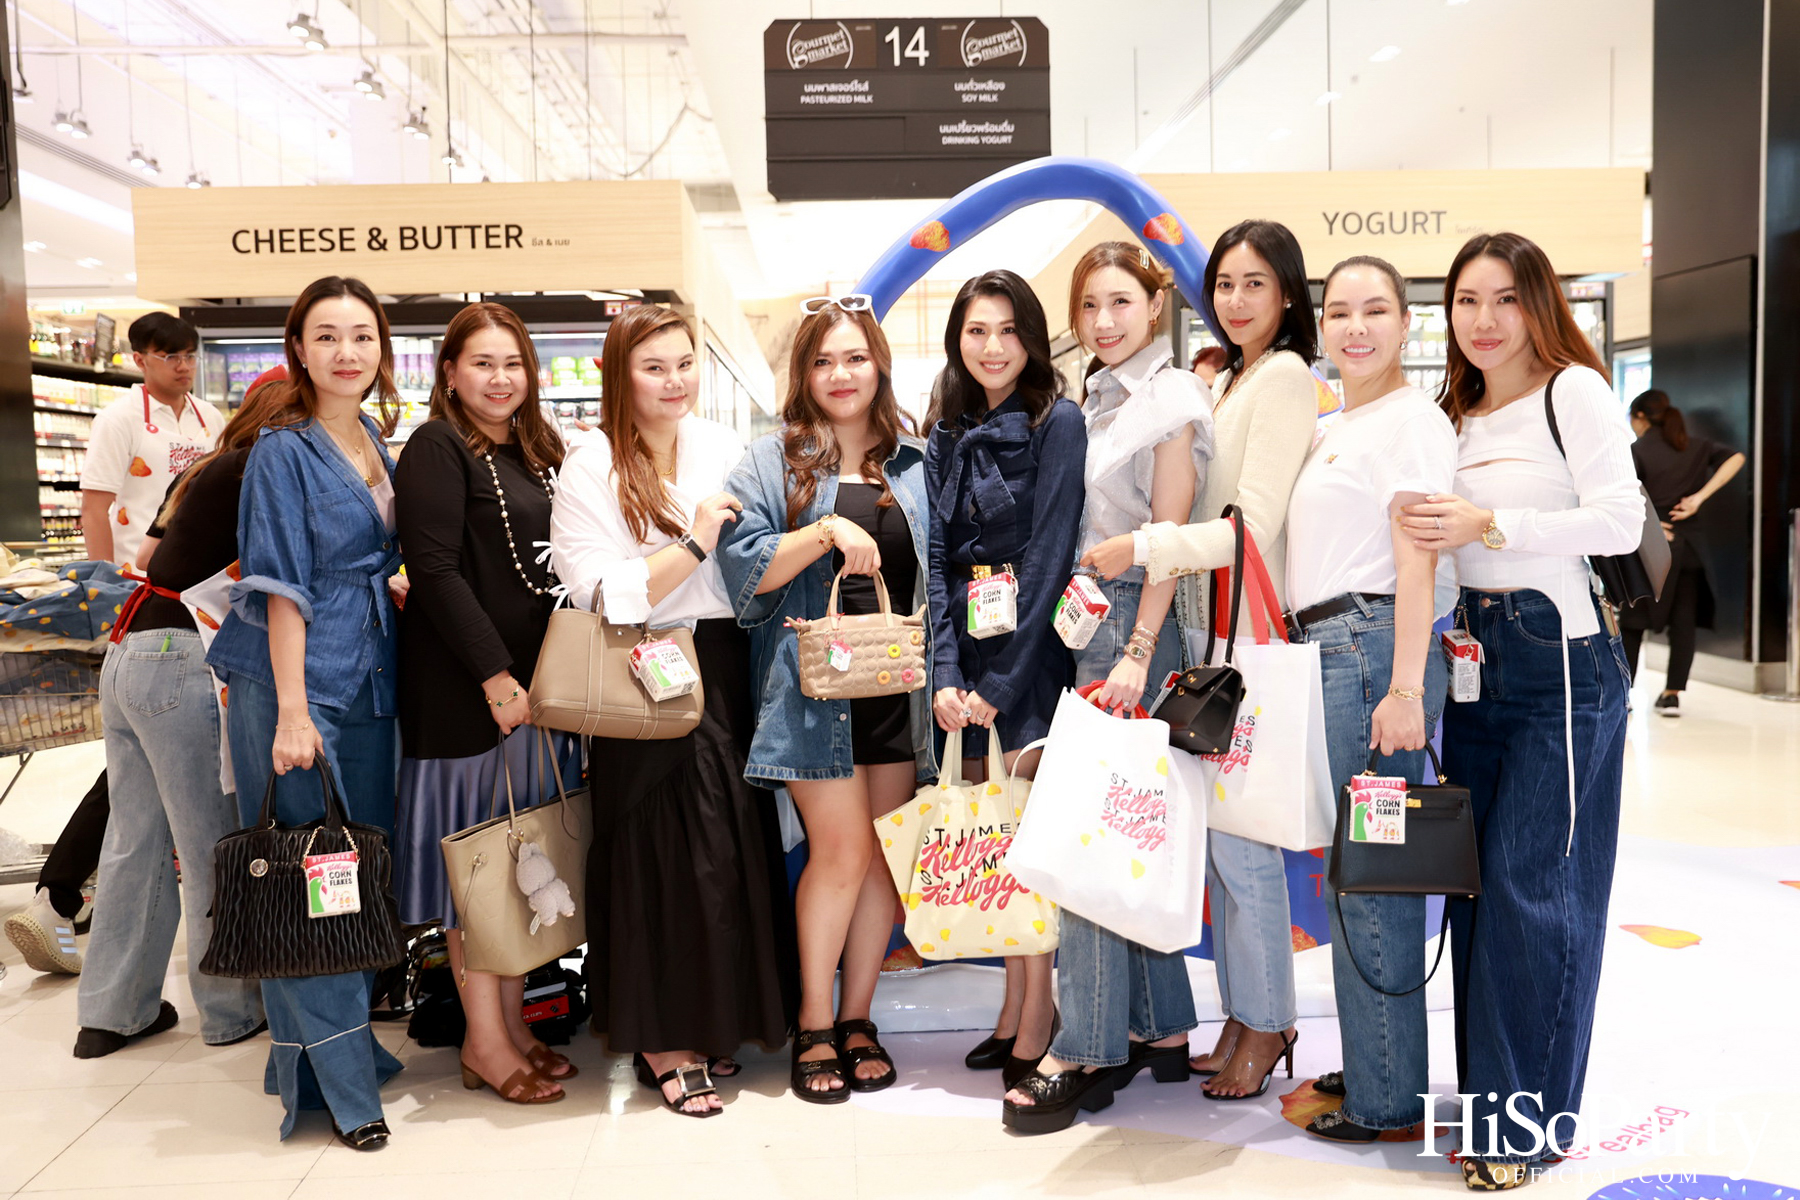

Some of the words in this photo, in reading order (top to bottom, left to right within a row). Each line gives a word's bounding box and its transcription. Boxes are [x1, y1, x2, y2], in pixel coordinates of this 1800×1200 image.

[807, 39, 850, 63] market
[885, 26, 930, 67] 14
[981, 38, 1023, 61] market
[800, 94, 852, 104] PASTEURIZED
[854, 94, 873, 103] MILK
[962, 93, 977, 103] SOY
[979, 93, 998, 102] MILK
[941, 135, 980, 145] DRINKING
[981, 135, 1013, 144] YOGURT
[1322, 210, 1447, 236] YOGURT
[231, 228, 356, 253] CHEESE
[367, 227, 388, 251] &
[399, 224, 524, 251] BUTTER
[983, 590, 1001, 598] CORN
[983, 596, 1001, 604] FLAKES
[1069, 602, 1081, 619] CORN
[1065, 608, 1078, 625] FLAKES
[1376, 799, 1400, 808] CORN
[1376, 808, 1400, 816] FLAKES
[312, 854, 350, 862] ST.JAMES
[329, 870, 352, 878] CORN
[330, 878, 352, 886] FLAKES
